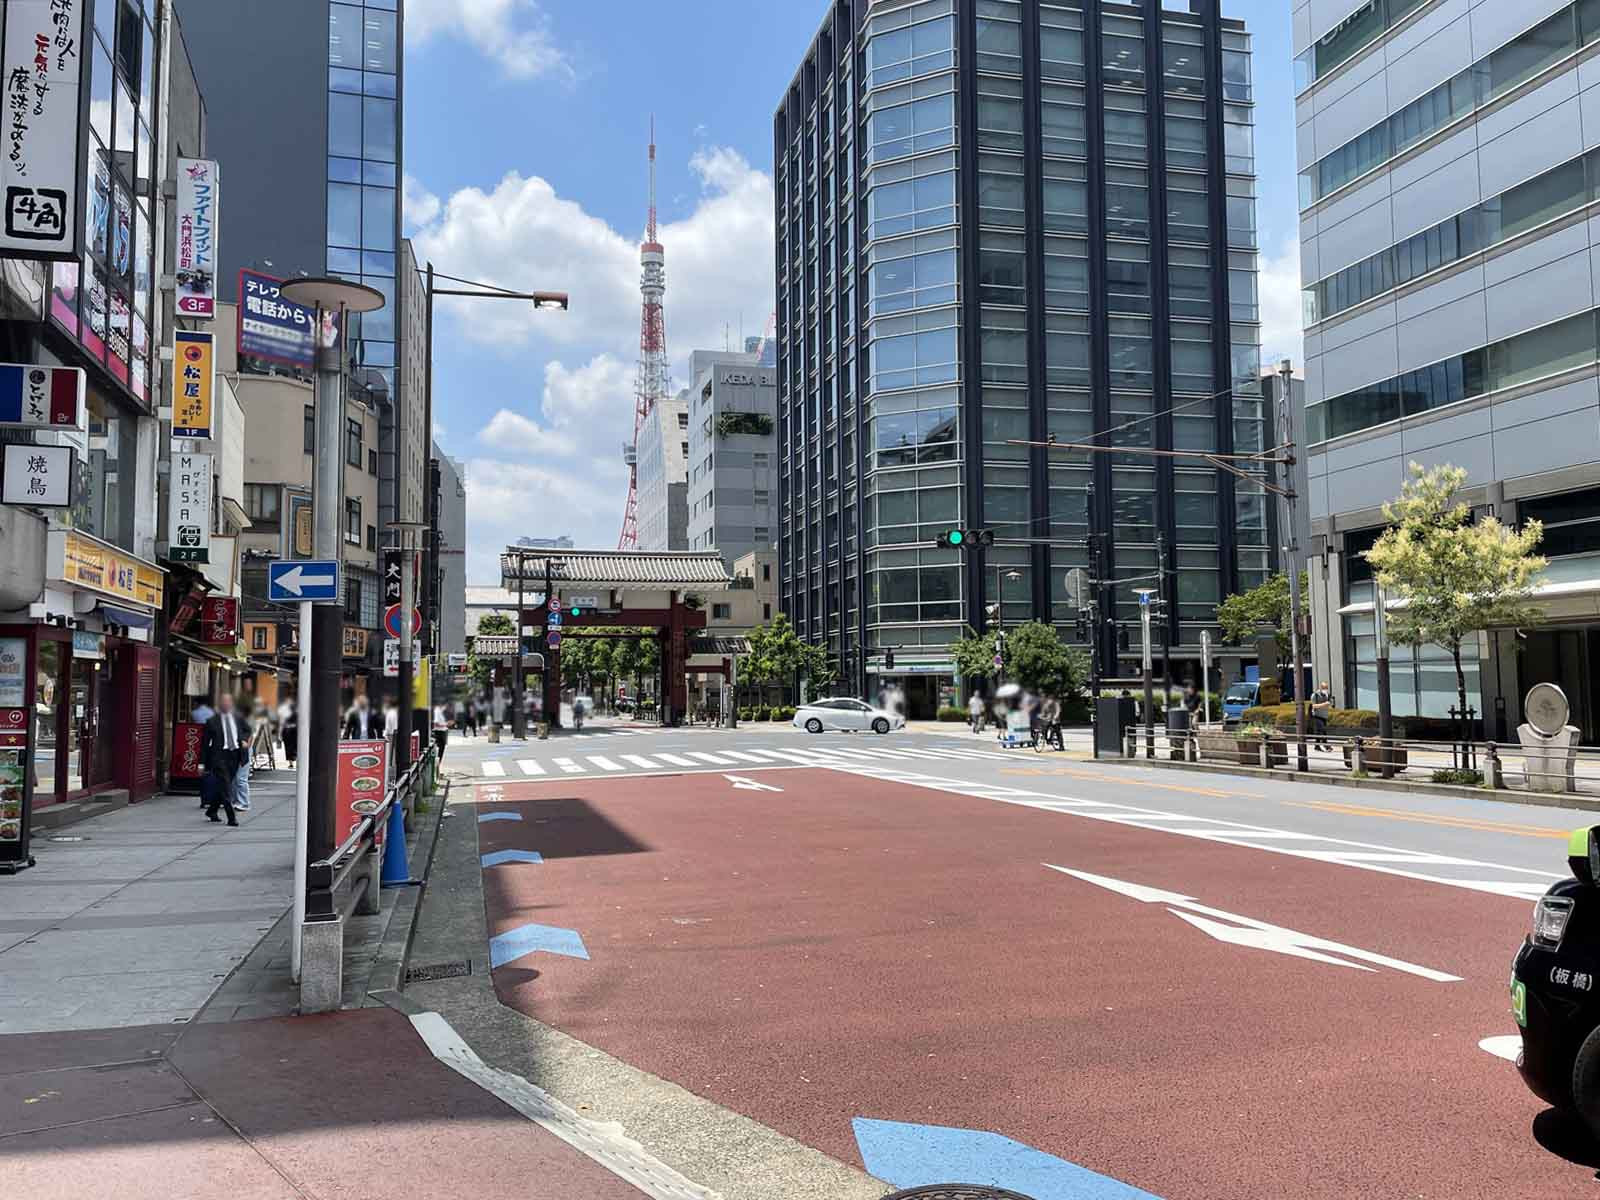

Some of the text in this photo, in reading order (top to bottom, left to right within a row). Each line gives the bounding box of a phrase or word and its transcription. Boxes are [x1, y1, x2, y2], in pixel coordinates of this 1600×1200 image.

[15, 197, 60, 229] 牛角
[180, 214, 193, 269] 大門浜松町
[187, 300, 206, 311] 3F
[246, 295, 307, 325] 電話から
[183, 365, 201, 398] 松屋
[27, 455, 48, 496] 焼鳥
[180, 457, 192, 521] MASA
[180, 551, 197, 559] 2F
[385, 562, 401, 610] 大門
